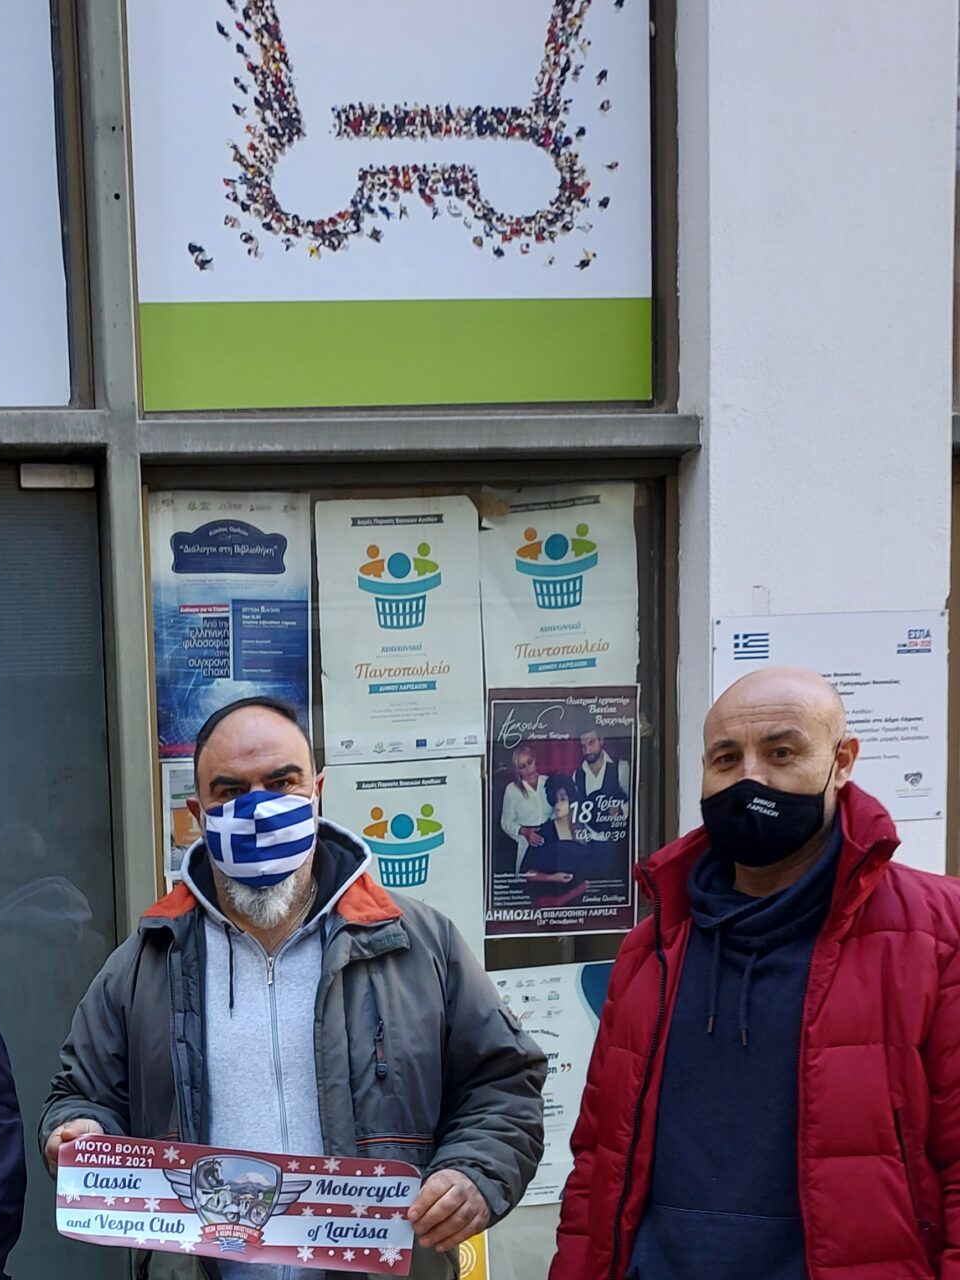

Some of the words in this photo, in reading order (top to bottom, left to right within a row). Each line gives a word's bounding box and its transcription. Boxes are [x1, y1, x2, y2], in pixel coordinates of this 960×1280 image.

[218, 546, 233, 556] στη
[514, 637, 610, 660] Παντοπωλείο
[354, 660, 451, 679] Παντοπωλείο
[569, 800, 594, 824] 18
[599, 830, 626, 841] 20:30
[486, 909, 542, 921] ΔΗΜΟΣΙΑ
[543, 910, 587, 919] ΒΙΒΛΙΟΘΗΚΗ
[588, 908, 618, 917] ΛΑΡΙΣΑΣ
[75, 1140, 111, 1152] ΜΟΤΟ
[115, 1144, 155, 1156] ΒΟΛΤΑ
[75, 1153, 122, 1166] ΑΓΑΠΗΣ
[125, 1156, 153, 1168] 2021
[83, 1171, 142, 1190] Classic
[315, 1179, 411, 1203] Motorcycle
[66, 1218, 91, 1229] and
[94, 1214, 145, 1235] Vespa
[149, 1216, 185, 1234] Club
[307, 1225, 322, 1241] of
[324, 1221, 389, 1243] Larissa
